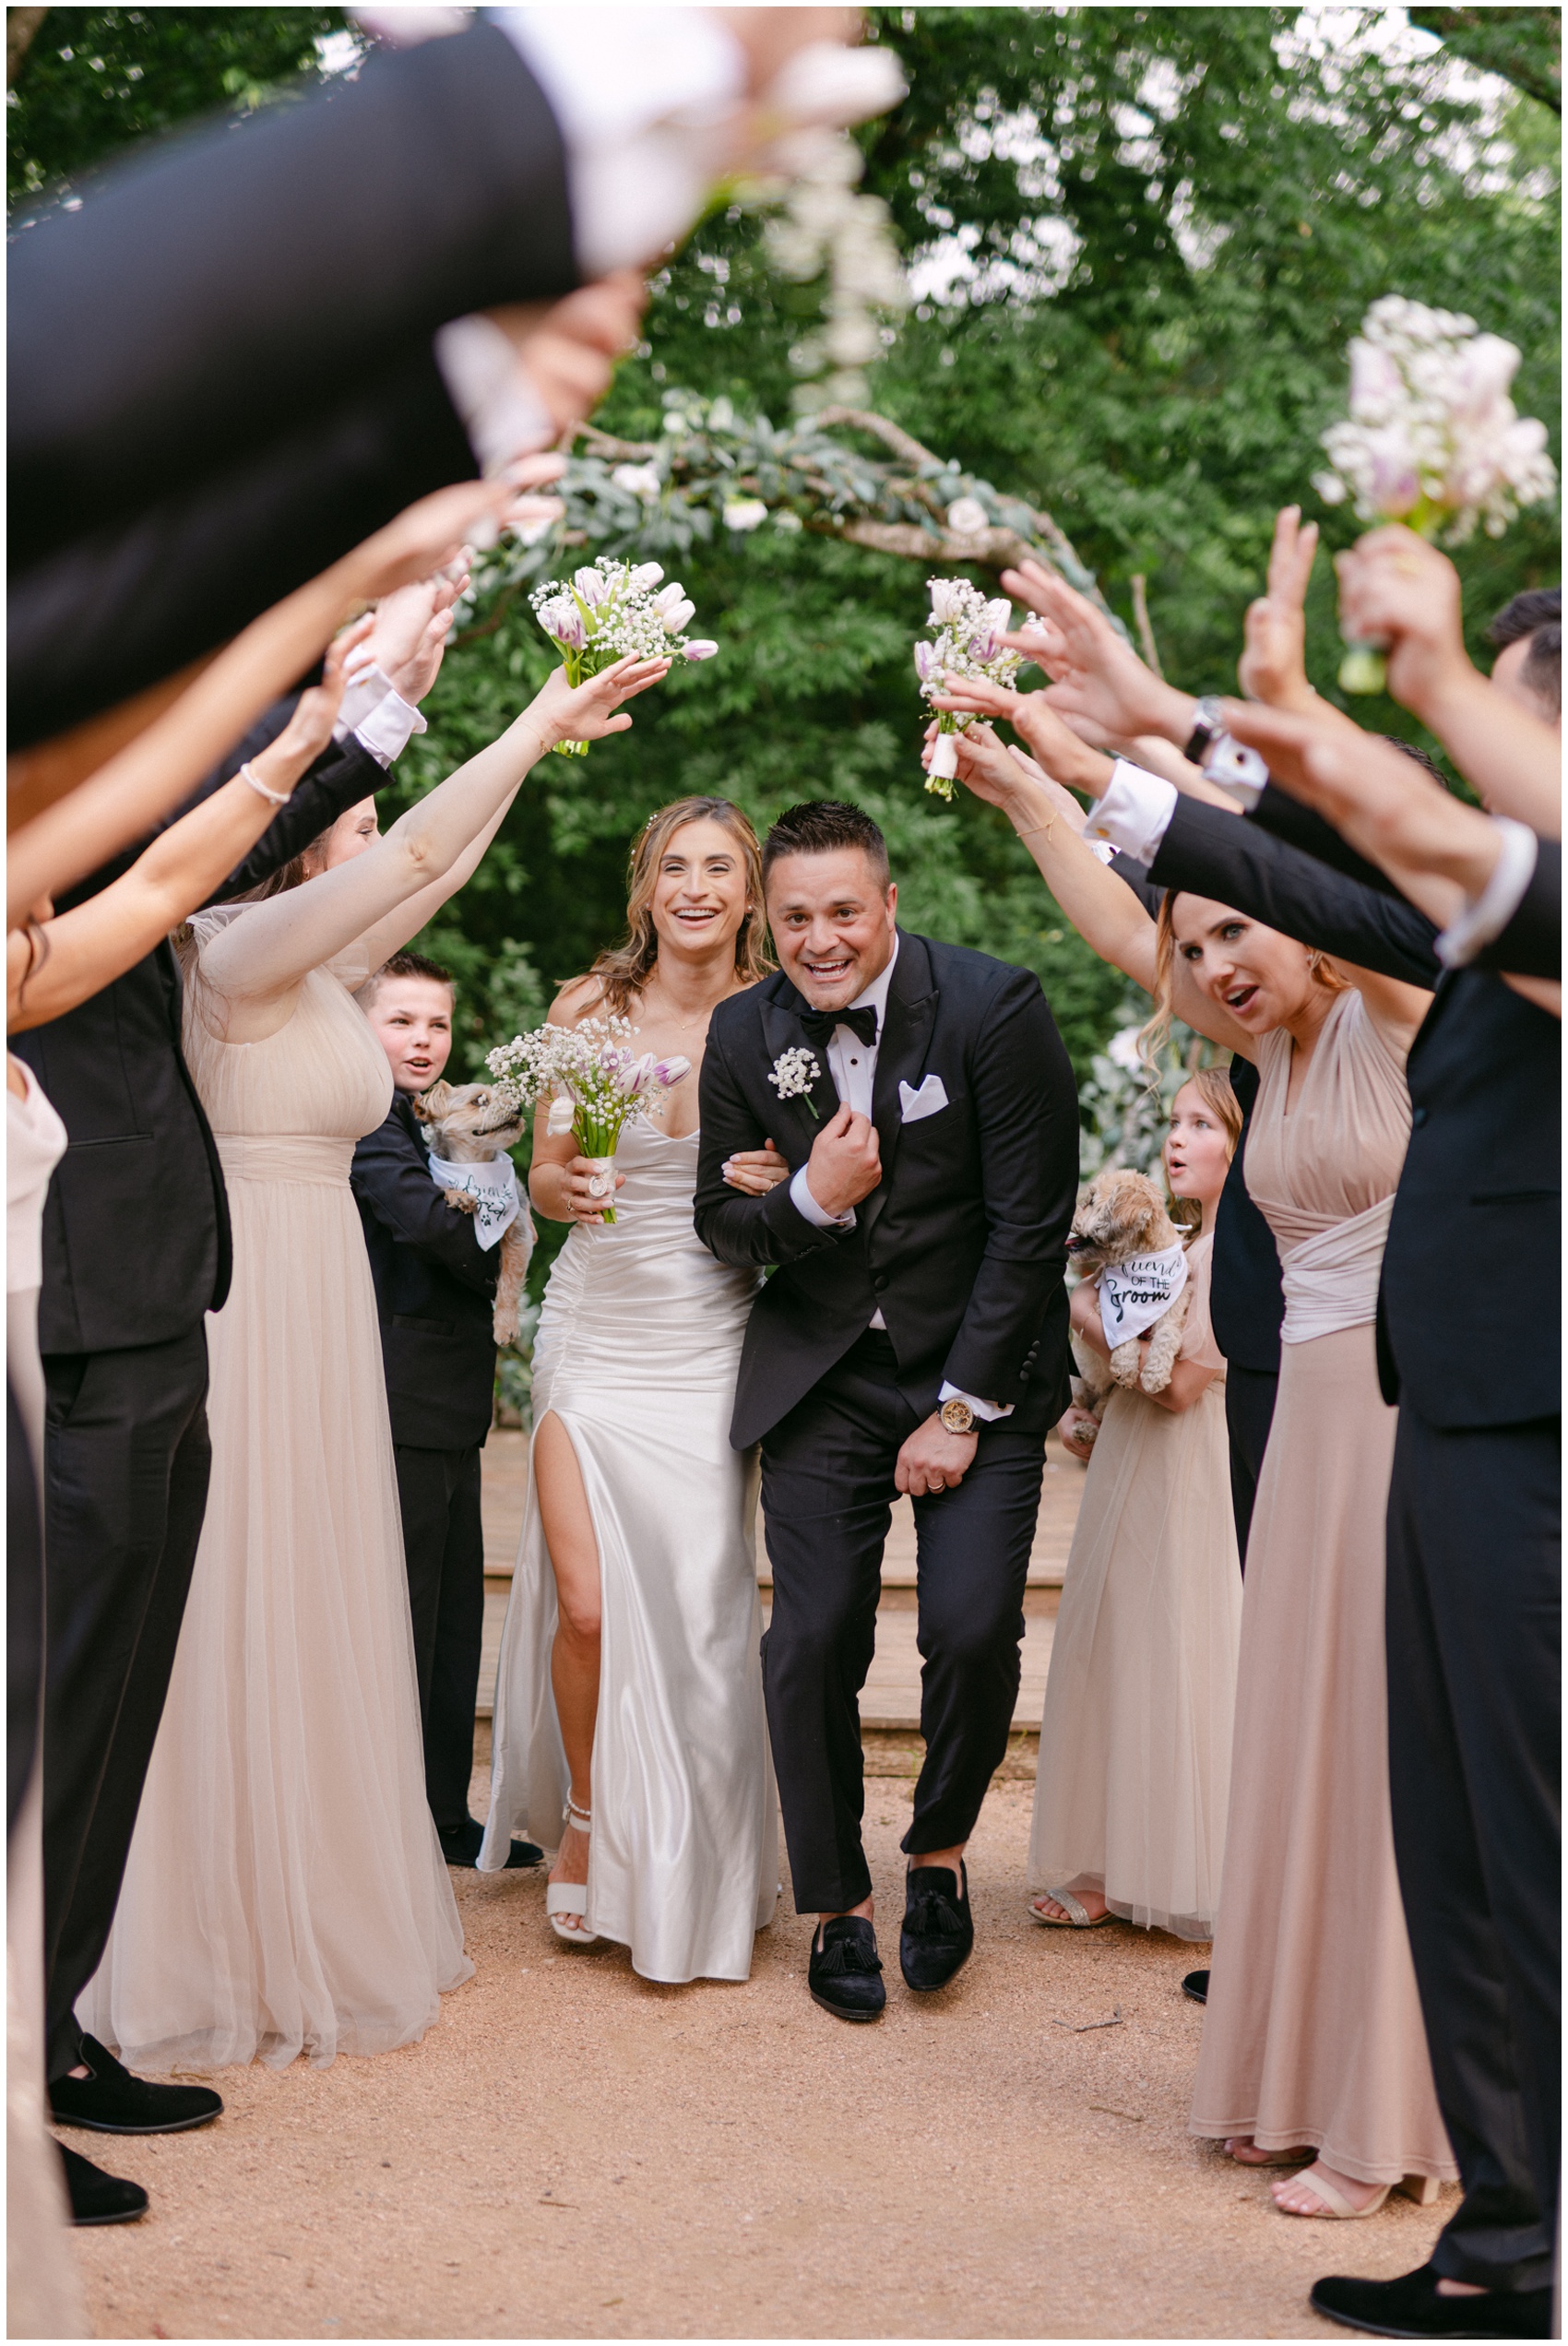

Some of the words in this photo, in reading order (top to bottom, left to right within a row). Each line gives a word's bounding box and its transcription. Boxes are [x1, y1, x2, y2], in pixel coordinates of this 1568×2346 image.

[1131, 1276, 1146, 1287] OF
[1150, 1277, 1170, 1290] THE
[1106, 1279, 1171, 1323] Groom
